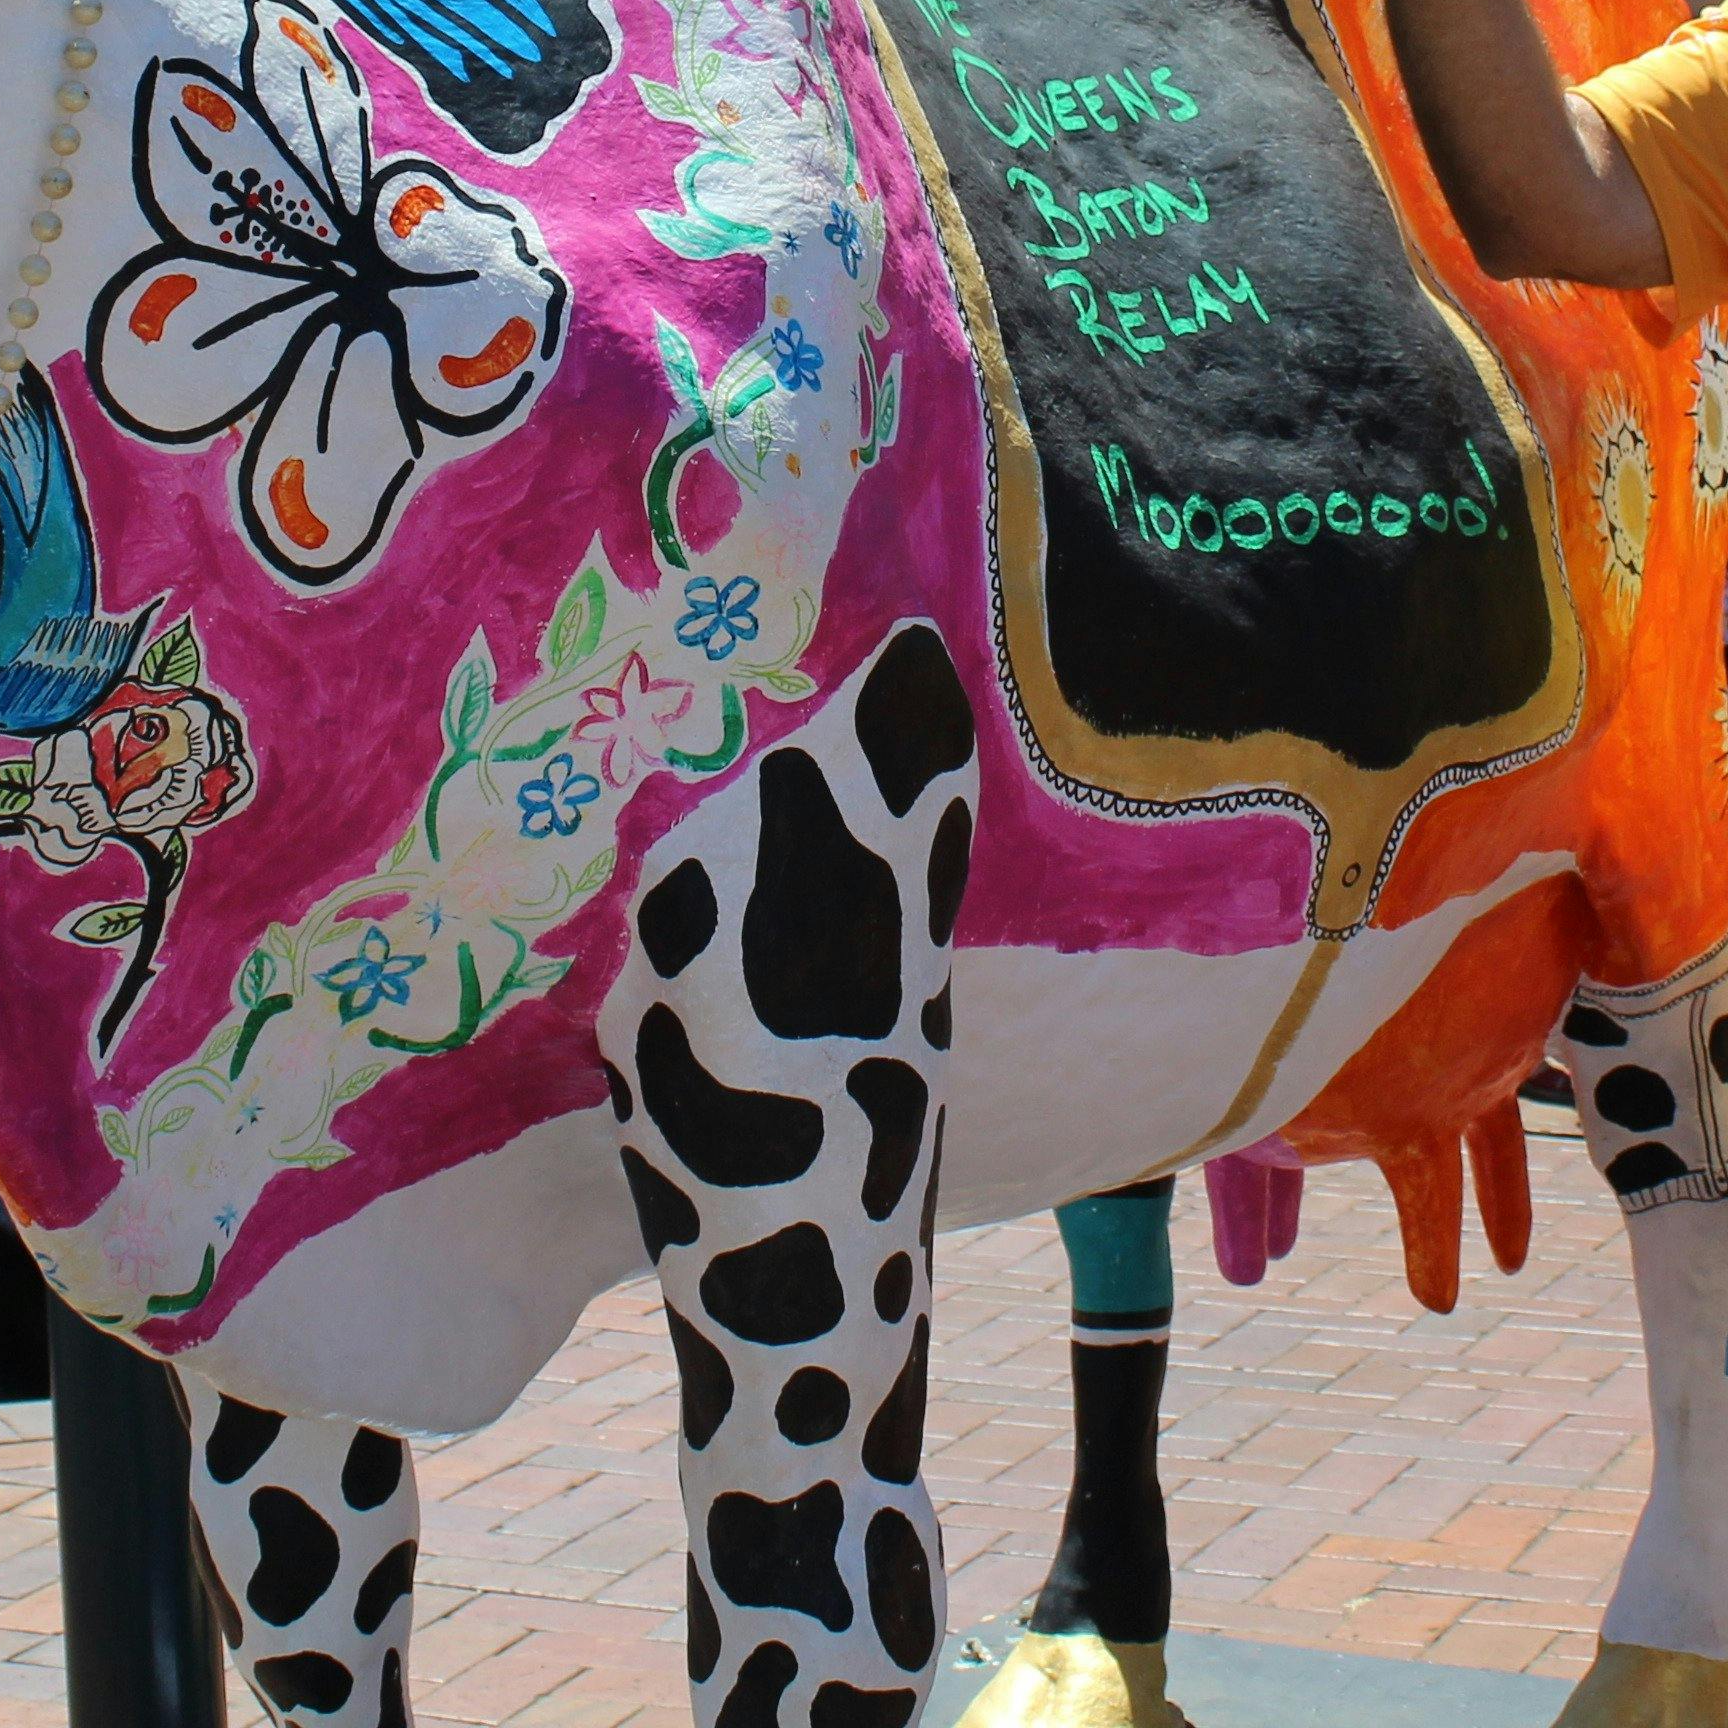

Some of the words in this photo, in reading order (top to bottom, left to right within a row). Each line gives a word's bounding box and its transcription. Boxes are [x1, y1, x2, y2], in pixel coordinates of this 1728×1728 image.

[951, 47, 1200, 152] QUEENS
[1006, 166, 1210, 261] BATON
[1044, 260, 1270, 367] RELAY
